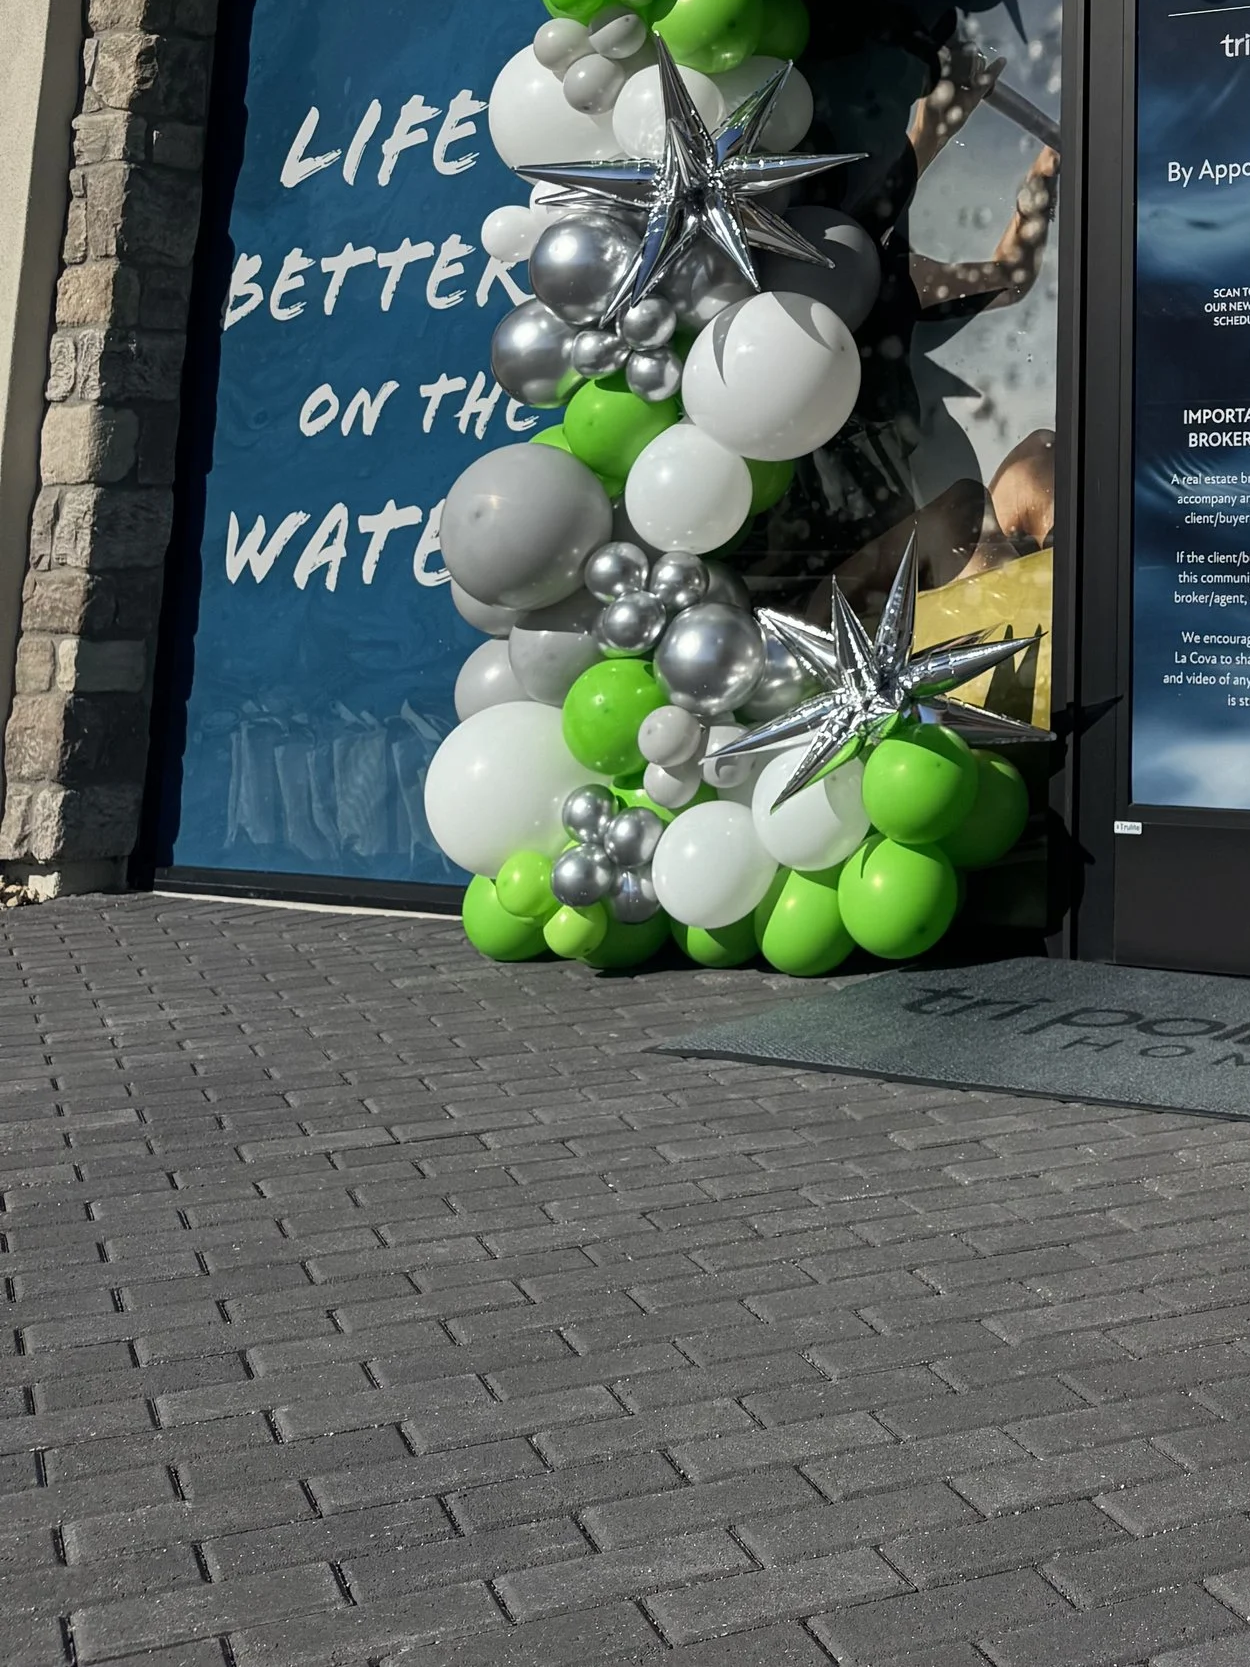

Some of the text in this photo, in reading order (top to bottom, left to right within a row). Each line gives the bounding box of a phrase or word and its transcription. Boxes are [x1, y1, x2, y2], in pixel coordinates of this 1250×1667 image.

[1220, 34, 1250, 57] tri
[280, 89, 488, 188] LIFE
[1169, 162, 1193, 187] By
[1214, 287, 1240, 298] SCAN
[1205, 302, 1227, 312] OUR
[300, 379, 400, 436] ON
[1172, 473, 1182, 486] A
[1182, 472, 1202, 486] real
[1204, 475, 1238, 485] estate
[1177, 493, 1237, 507] accompany
[1185, 512, 1250, 527] client/buyer
[1177, 551, 1184, 563] If
[1187, 551, 1205, 563] the
[1179, 571, 1198, 583] this
[1175, 591, 1247, 607] broker/agent,
[1182, 632, 1200, 643] We
[1175, 652, 1187, 663] La
[1190, 652, 1217, 664] Cova
[1220, 655, 1232, 664] to
[1163, 672, 1183, 684] and
[1186, 672, 1216, 684] video
[1219, 673, 1230, 685] of
[1228, 694, 1236, 706] is
[902, 985, 1053, 1022] tri
